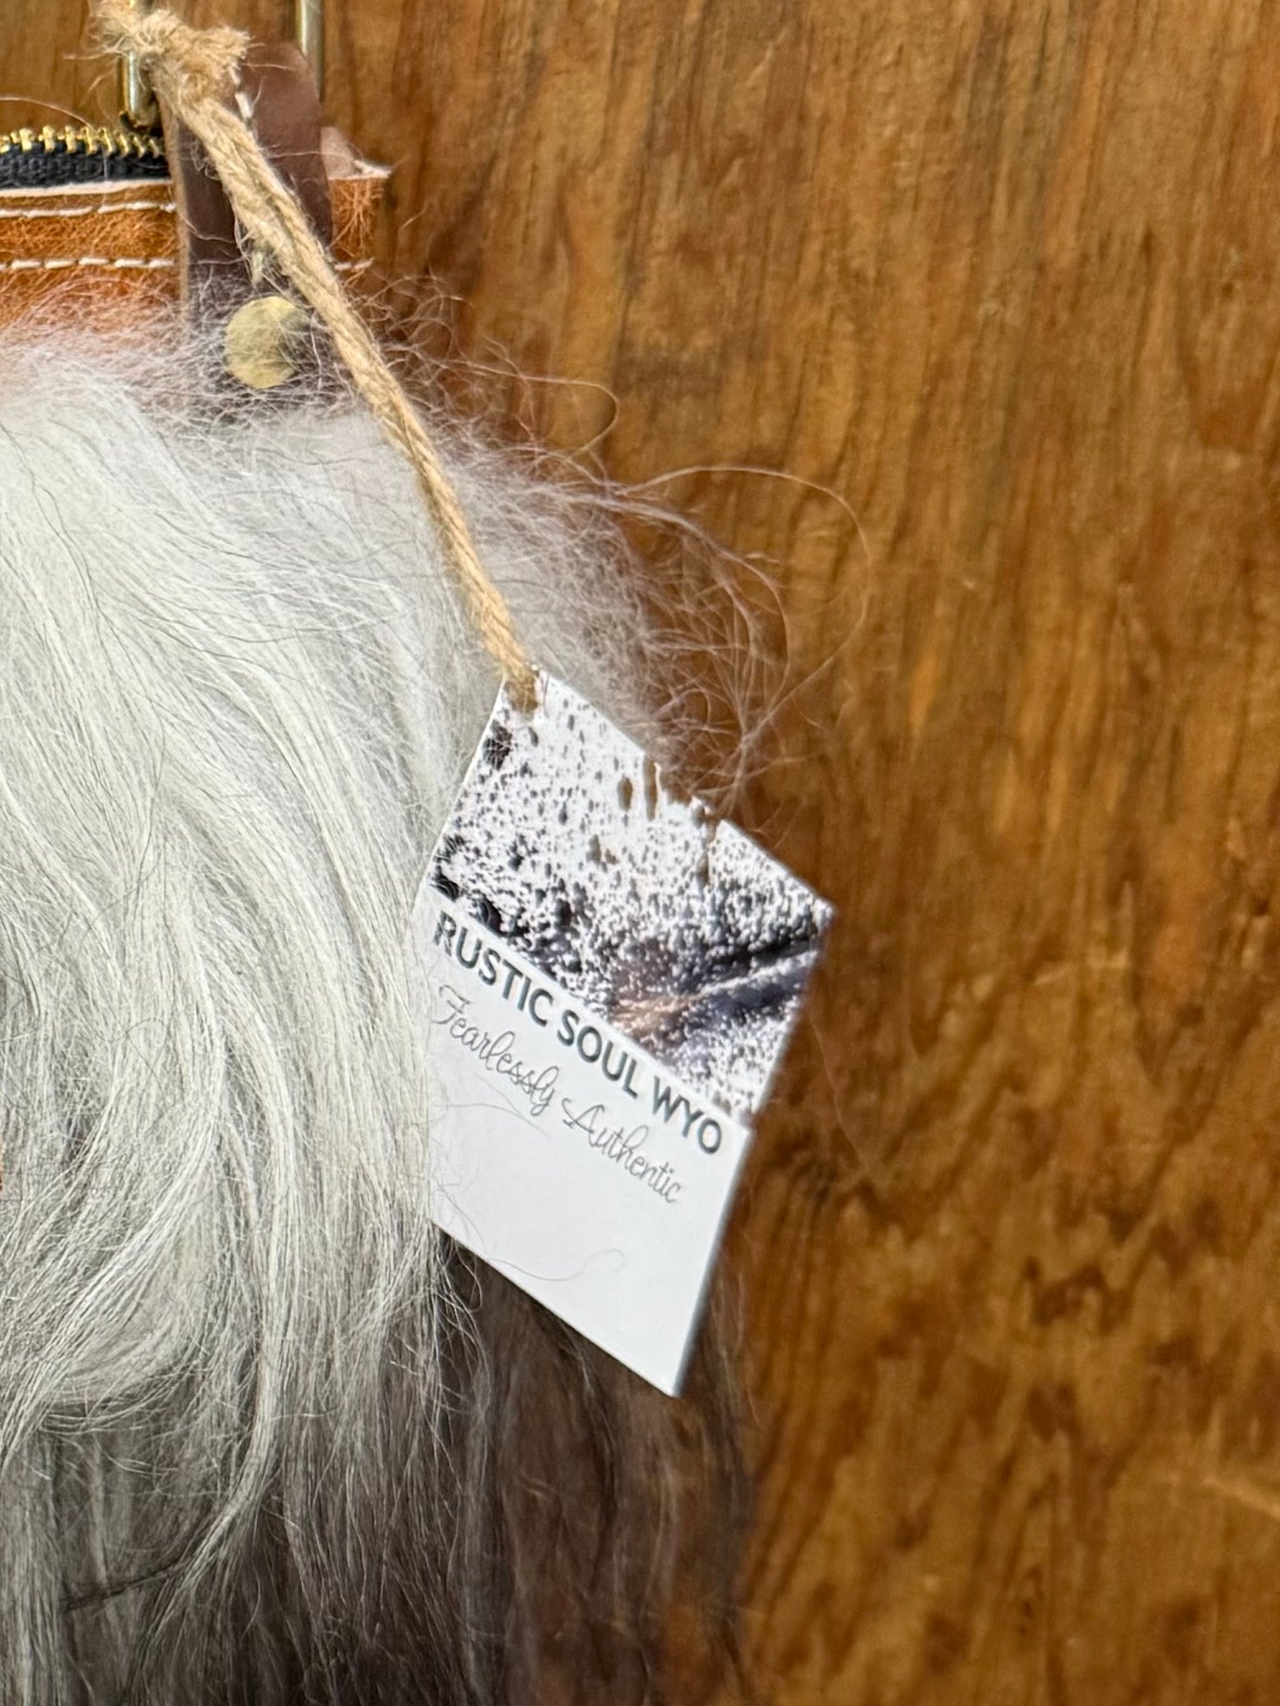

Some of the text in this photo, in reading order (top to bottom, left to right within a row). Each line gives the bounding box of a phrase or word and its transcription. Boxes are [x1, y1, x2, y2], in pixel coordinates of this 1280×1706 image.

[431, 983, 682, 1204] Fearlessly Authentic
[433, 910, 723, 1155] RUSTIC SOUL WYO
